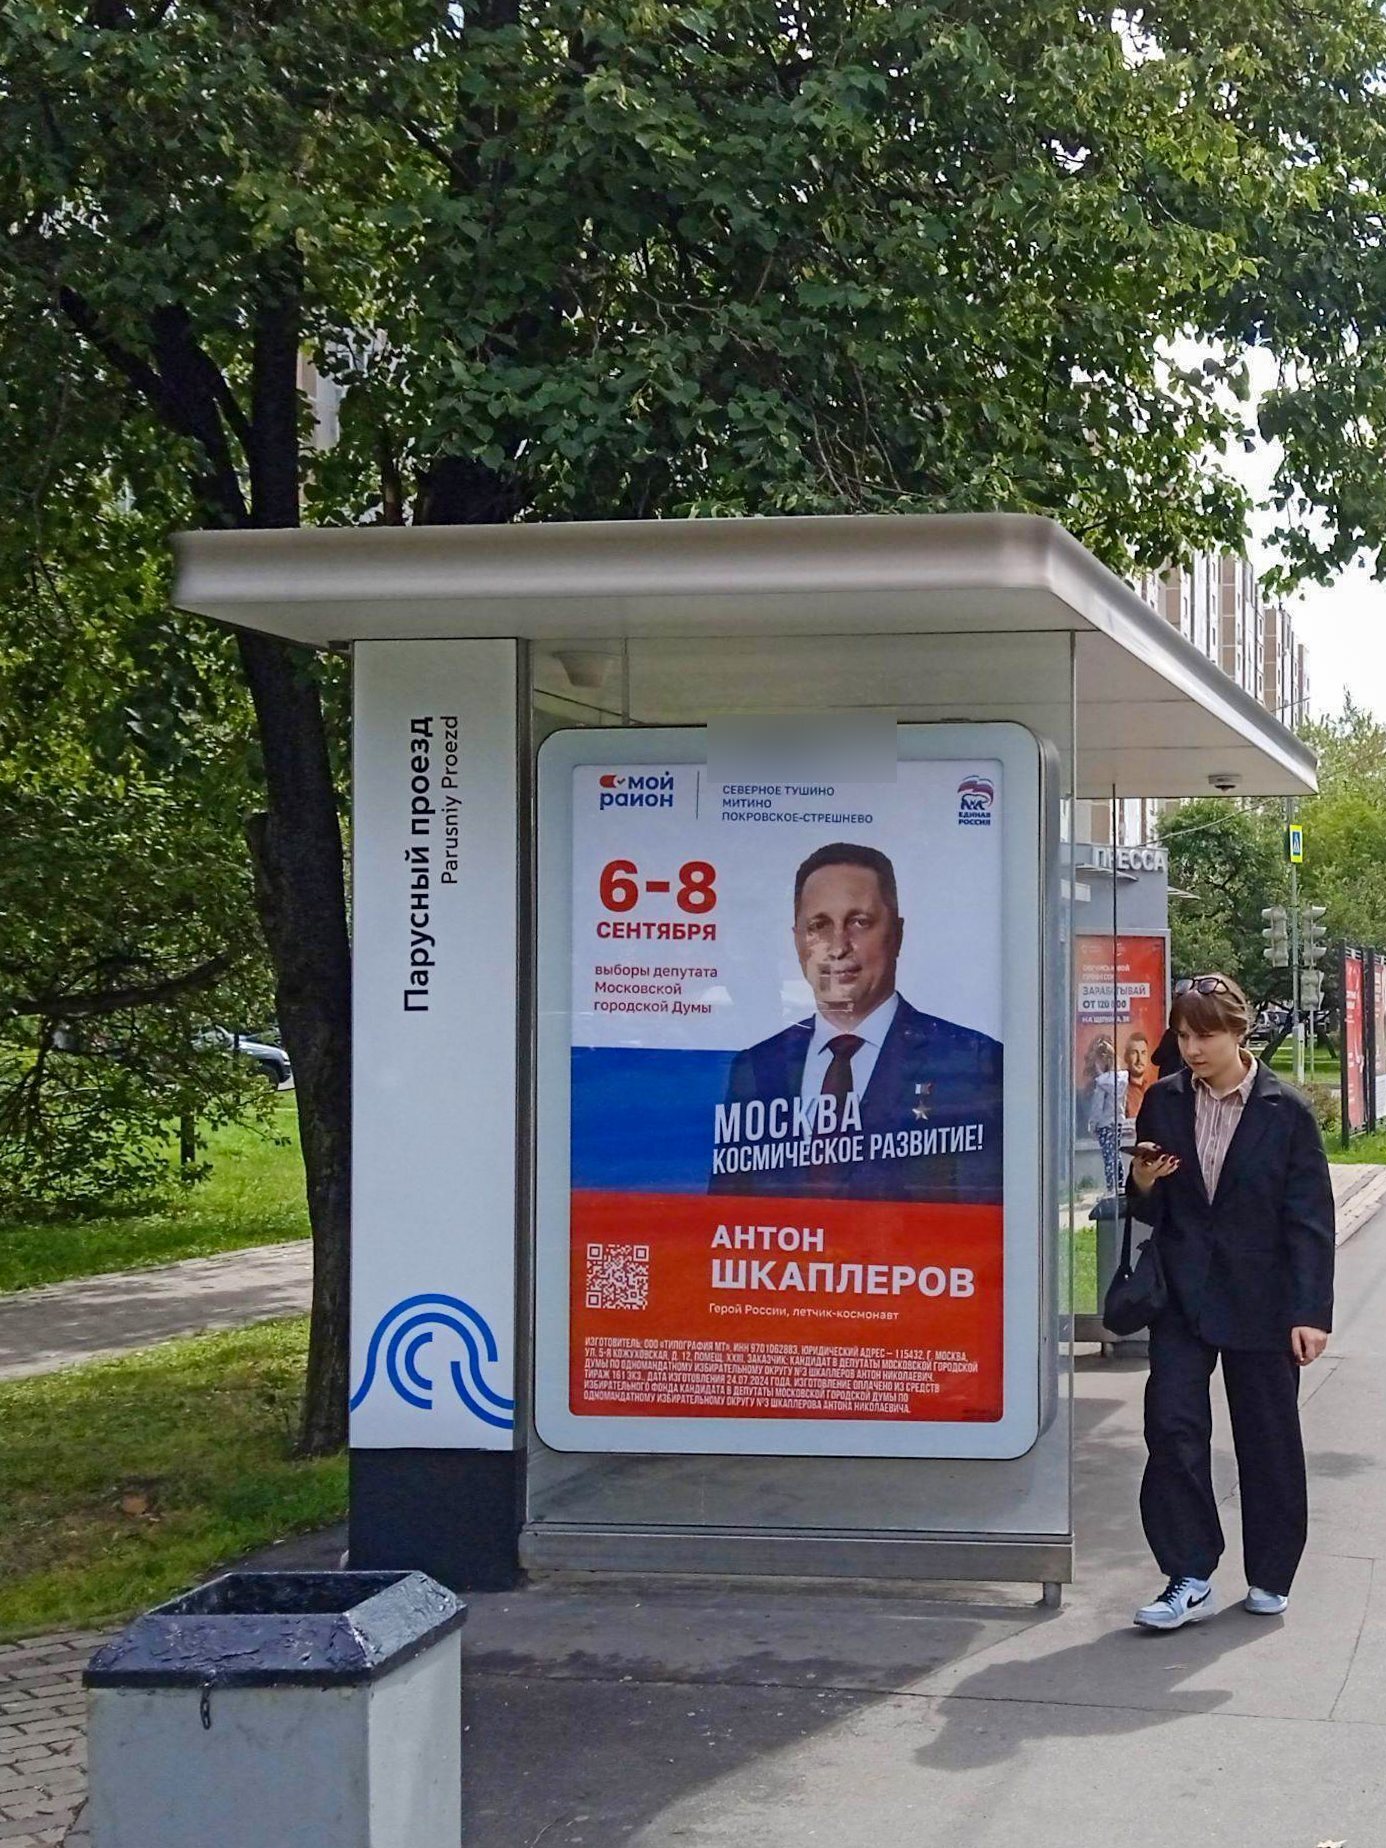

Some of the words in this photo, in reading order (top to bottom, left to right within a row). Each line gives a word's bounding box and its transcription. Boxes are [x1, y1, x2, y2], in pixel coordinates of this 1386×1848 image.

[440, 716, 458, 788] Proezd
[411, 716, 436, 835] проезд
[722, 785, 781, 796] СЕВЕРНОЕ
[784, 786, 835, 796] ТУШИНО
[722, 798, 772, 808] МИТИНО
[722, 812, 873, 823] ПОКРОВСКОЕ-СТРЕШНЕВО
[441, 795, 462, 884] Parusniy
[404, 846, 435, 1011] Парусный
[596, 921, 716, 941] СЕНТЯБРЯ
[595, 963, 650, 978] выборы
[653, 967, 718, 980] депутата
[594, 981, 682, 995] Московской
[594, 1001, 668, 1014] городской
[672, 1001, 711, 1015] Думы
[1082, 1000, 1096, 1009] ОТ
[714, 1091, 863, 1144] МОСКВА
[712, 1135, 864, 1174] КОСМИЧЕСКОЕ
[870, 1124, 984, 1161] РАЗВИТИЕ!
[711, 1224, 824, 1252] АНТОН
[711, 1258, 975, 1298] ШКАПЛЕРОВ
[709, 1303, 743, 1317] Герой
[745, 1305, 790, 1318] России,
[793, 1308, 899, 1320] летчик-космонавт
[644, 1338, 658, 1349] ООО
[733, 1342, 749, 1352] ИНН
[801, 1344, 858, 1357] ЮРИДИЧЕСКИЙ
[860, 1347, 884, 1358] АДРЕС
[584, 1347, 596, 1357] УЛ.
[599, 1347, 611, 1358] 5-Я
[789, 1355, 831, 1367] КАНДИДАТ
[839, 1357, 880, 1369] ДЕПУТАТЫ
[882, 1358, 932, 1370] МОСКОВСКОЙ
[933, 1360, 978, 1373] ГОРОДСКОЙ
[584, 1358, 608, 1369] ДУМЫ
[610, 1359, 619, 1369] ПО
[621, 1359, 693, 1372] ОДНОМАНДАТНОМУ
[694, 1362, 763, 1374] ИЗБИРАТЕЛЬНОМУ
[764, 1365, 792, 1376] ОКРУГУ
[808, 1367, 854, 1378] ШКАПЛЕРОВ
[856, 1368, 881, 1379] АНТОН
[584, 1368, 609, 1379] ТИРАЖ
[647, 1371, 666, 1382] ДАТА
[668, 1372, 725, 1384] ИЗГОТОВЛЕНИЯ
[726, 1374, 769, 1386] 24.07.2024
[793, 1377, 851, 1389] ИЗГОТОВЛЕНИЕ
[852, 1379, 892, 1391] ОПЛАЧЕНО
[894, 1381, 904, 1391] ИЗ
[905, 1381, 940, 1393] СРЕДСТВ
[584, 1379, 650, 1392] ИЗБИРАТЕЛЬНОГО
[651, 1382, 678, 1394] ФОНДА
[680, 1383, 724, 1395] КАНДИДАТА
[733, 1385, 773, 1397] ДЕПУТАТЫ
[775, 1386, 825, 1399] МОСКОВСКОЙ
[826, 1388, 870, 1401] ГОРОДСКОЙ
[872, 1391, 896, 1402] ДУМЫ
[898, 1392, 908, 1402] ПО
[584, 1390, 655, 1403] ОДНОМАНДАТНОМУ
[657, 1393, 725, 1406] ИЗБИРАТЕЛЬНОМУ
[726, 1396, 755, 1407] ОКРУГУ
[770, 1398, 821, 1409] ШКАПЛЕРОВА
[823, 1400, 852, 1411] АНТОНА
